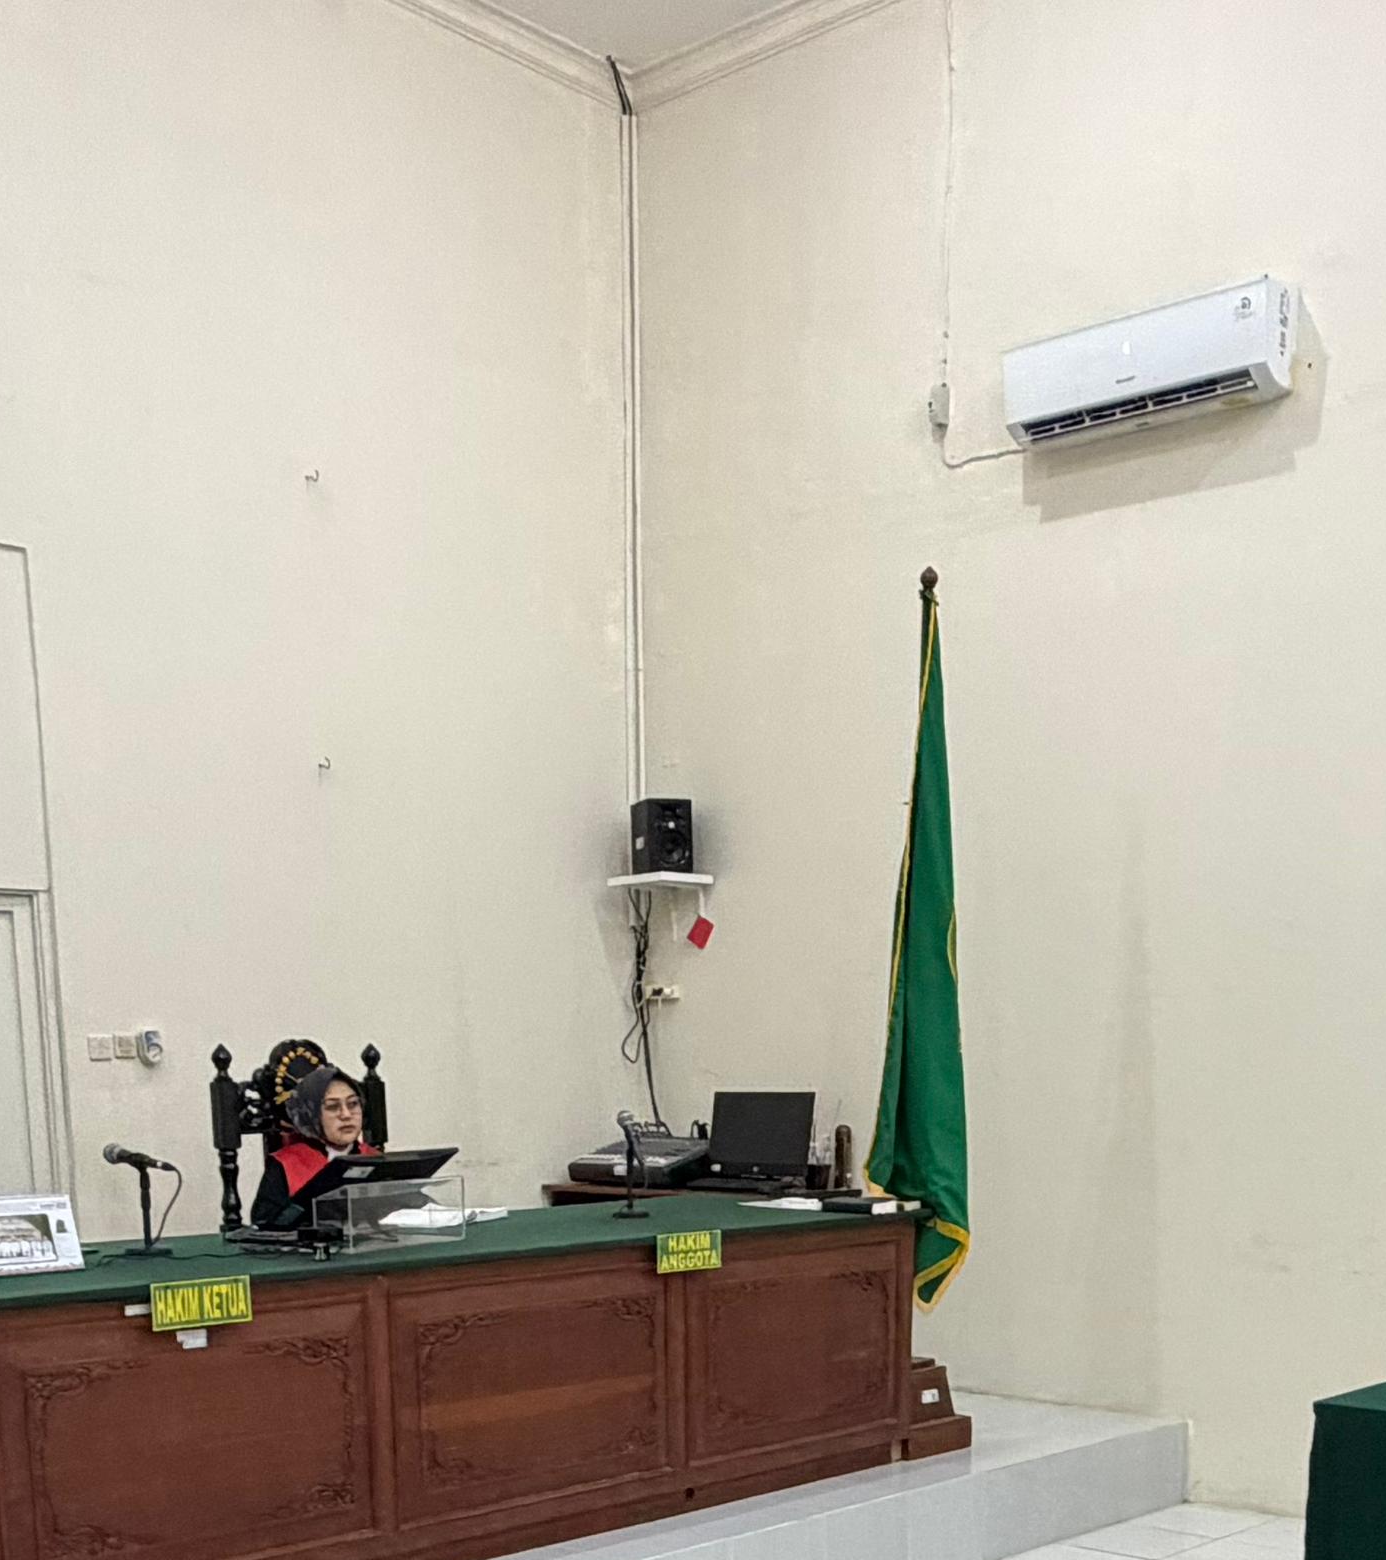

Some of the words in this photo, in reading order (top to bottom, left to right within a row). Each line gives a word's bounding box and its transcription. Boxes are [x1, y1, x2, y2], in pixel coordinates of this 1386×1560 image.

[668, 1231, 711, 1252] HAKIM
[660, 1249, 719, 1271] ANGGOTA
[155, 1286, 200, 1325] HAKIM
[202, 1281, 247, 1319] KETUA
